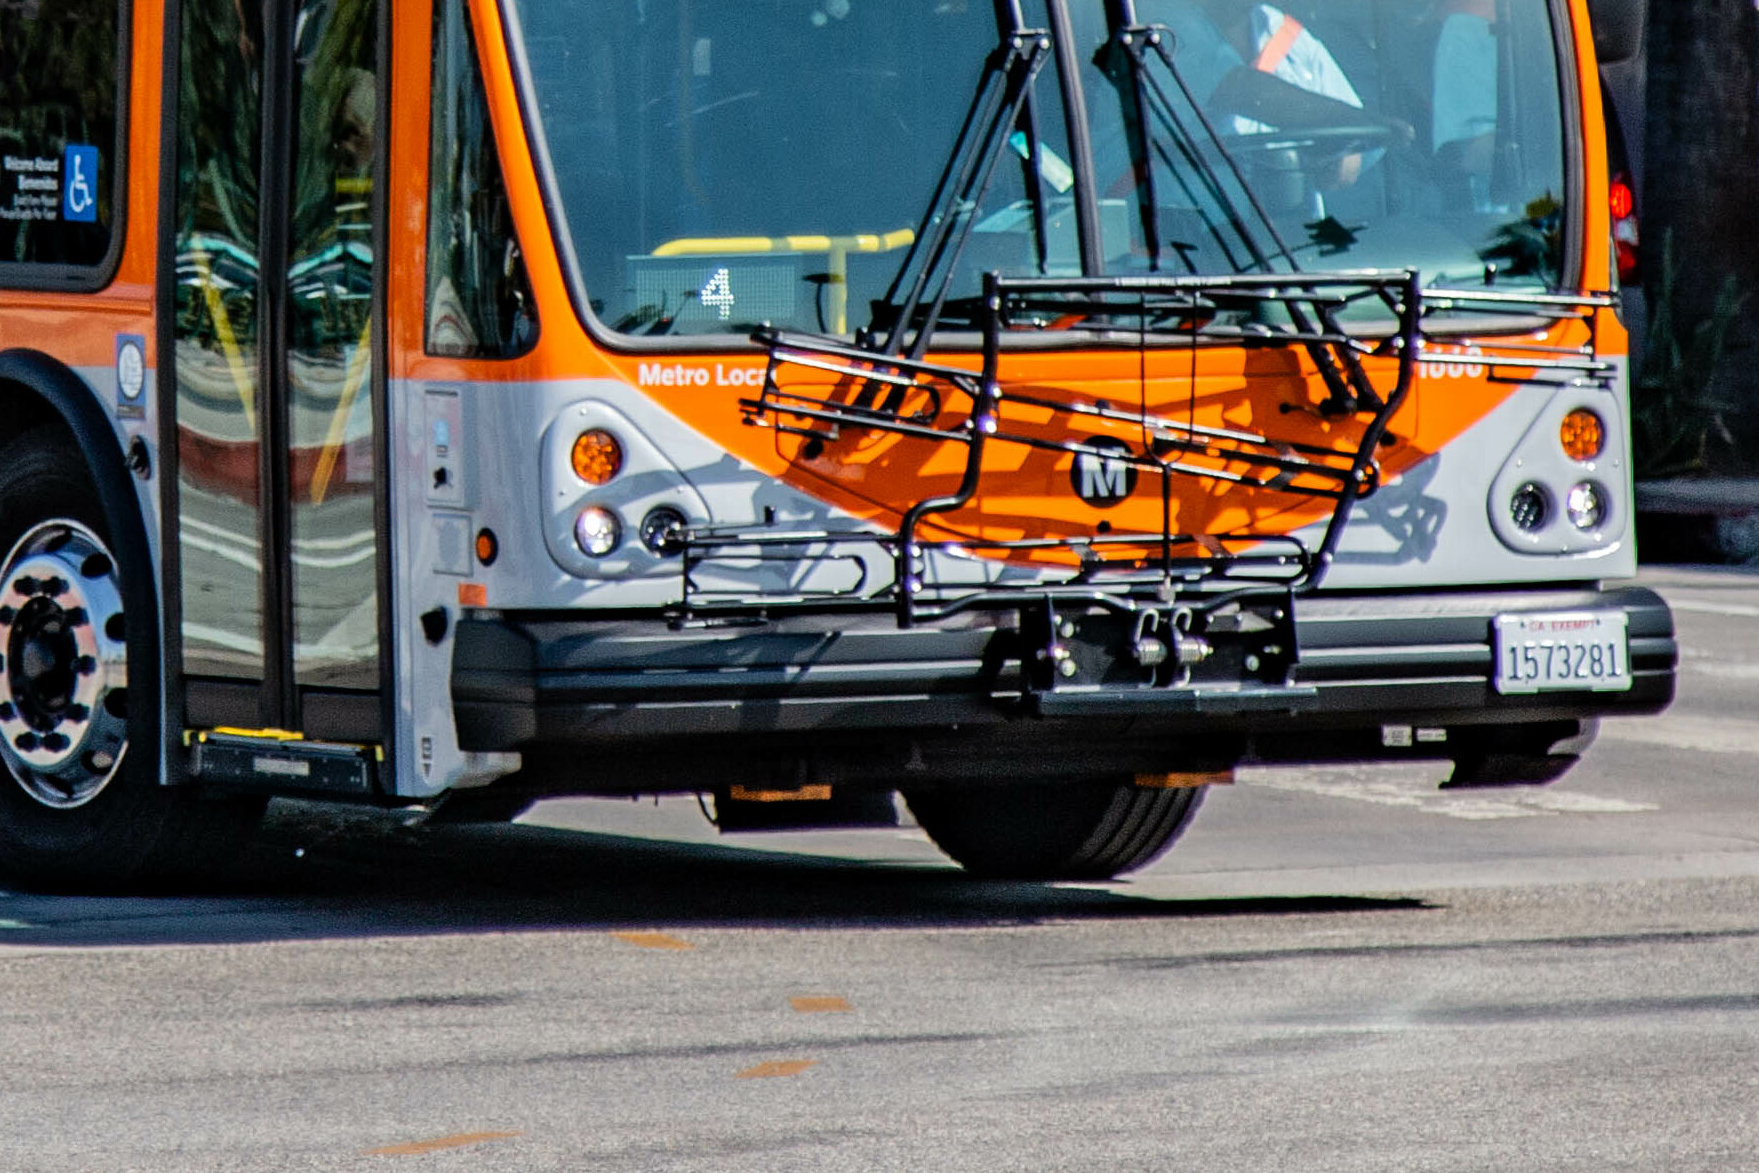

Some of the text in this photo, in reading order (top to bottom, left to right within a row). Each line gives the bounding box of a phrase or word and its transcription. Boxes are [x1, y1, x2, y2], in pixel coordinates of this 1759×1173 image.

[701, 267, 734, 321] 4
[638, 363, 709, 386] Metro
[1508, 642, 1622, 681] 1573281
